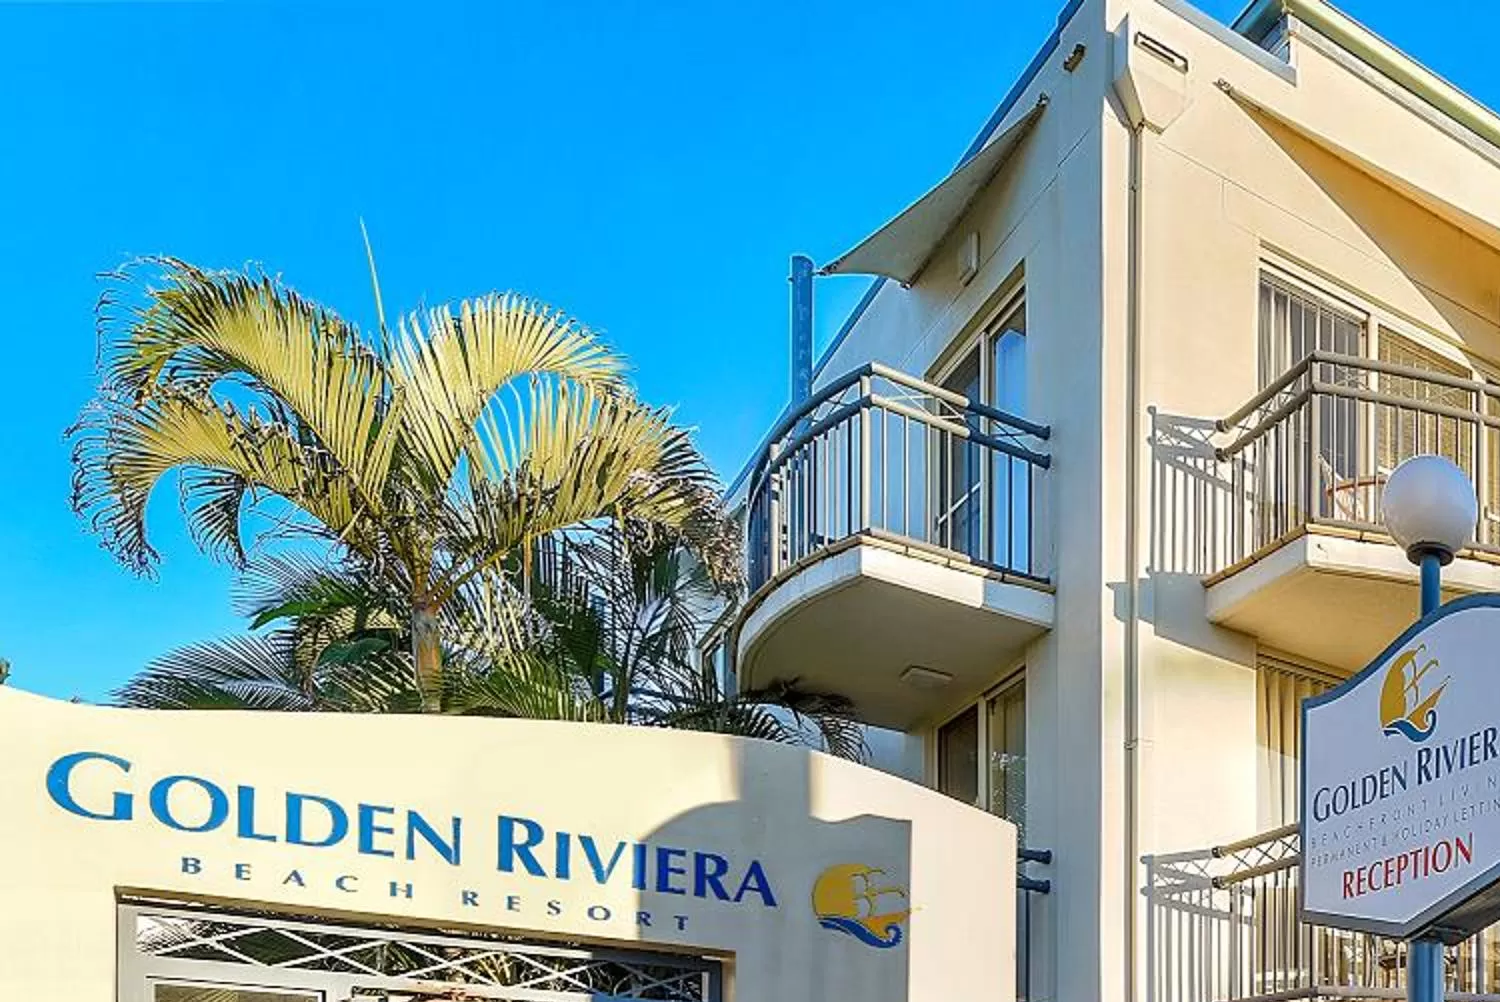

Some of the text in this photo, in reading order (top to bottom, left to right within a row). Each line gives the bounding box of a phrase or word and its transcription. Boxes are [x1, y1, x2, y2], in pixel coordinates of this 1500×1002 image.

[1313, 761, 1407, 822] GOLDEN
[45, 751, 777, 907] GOLDEN RIVIERA
[181, 857, 690, 931] BEACH RESORT
[1343, 832, 1473, 900] RECEPTION
